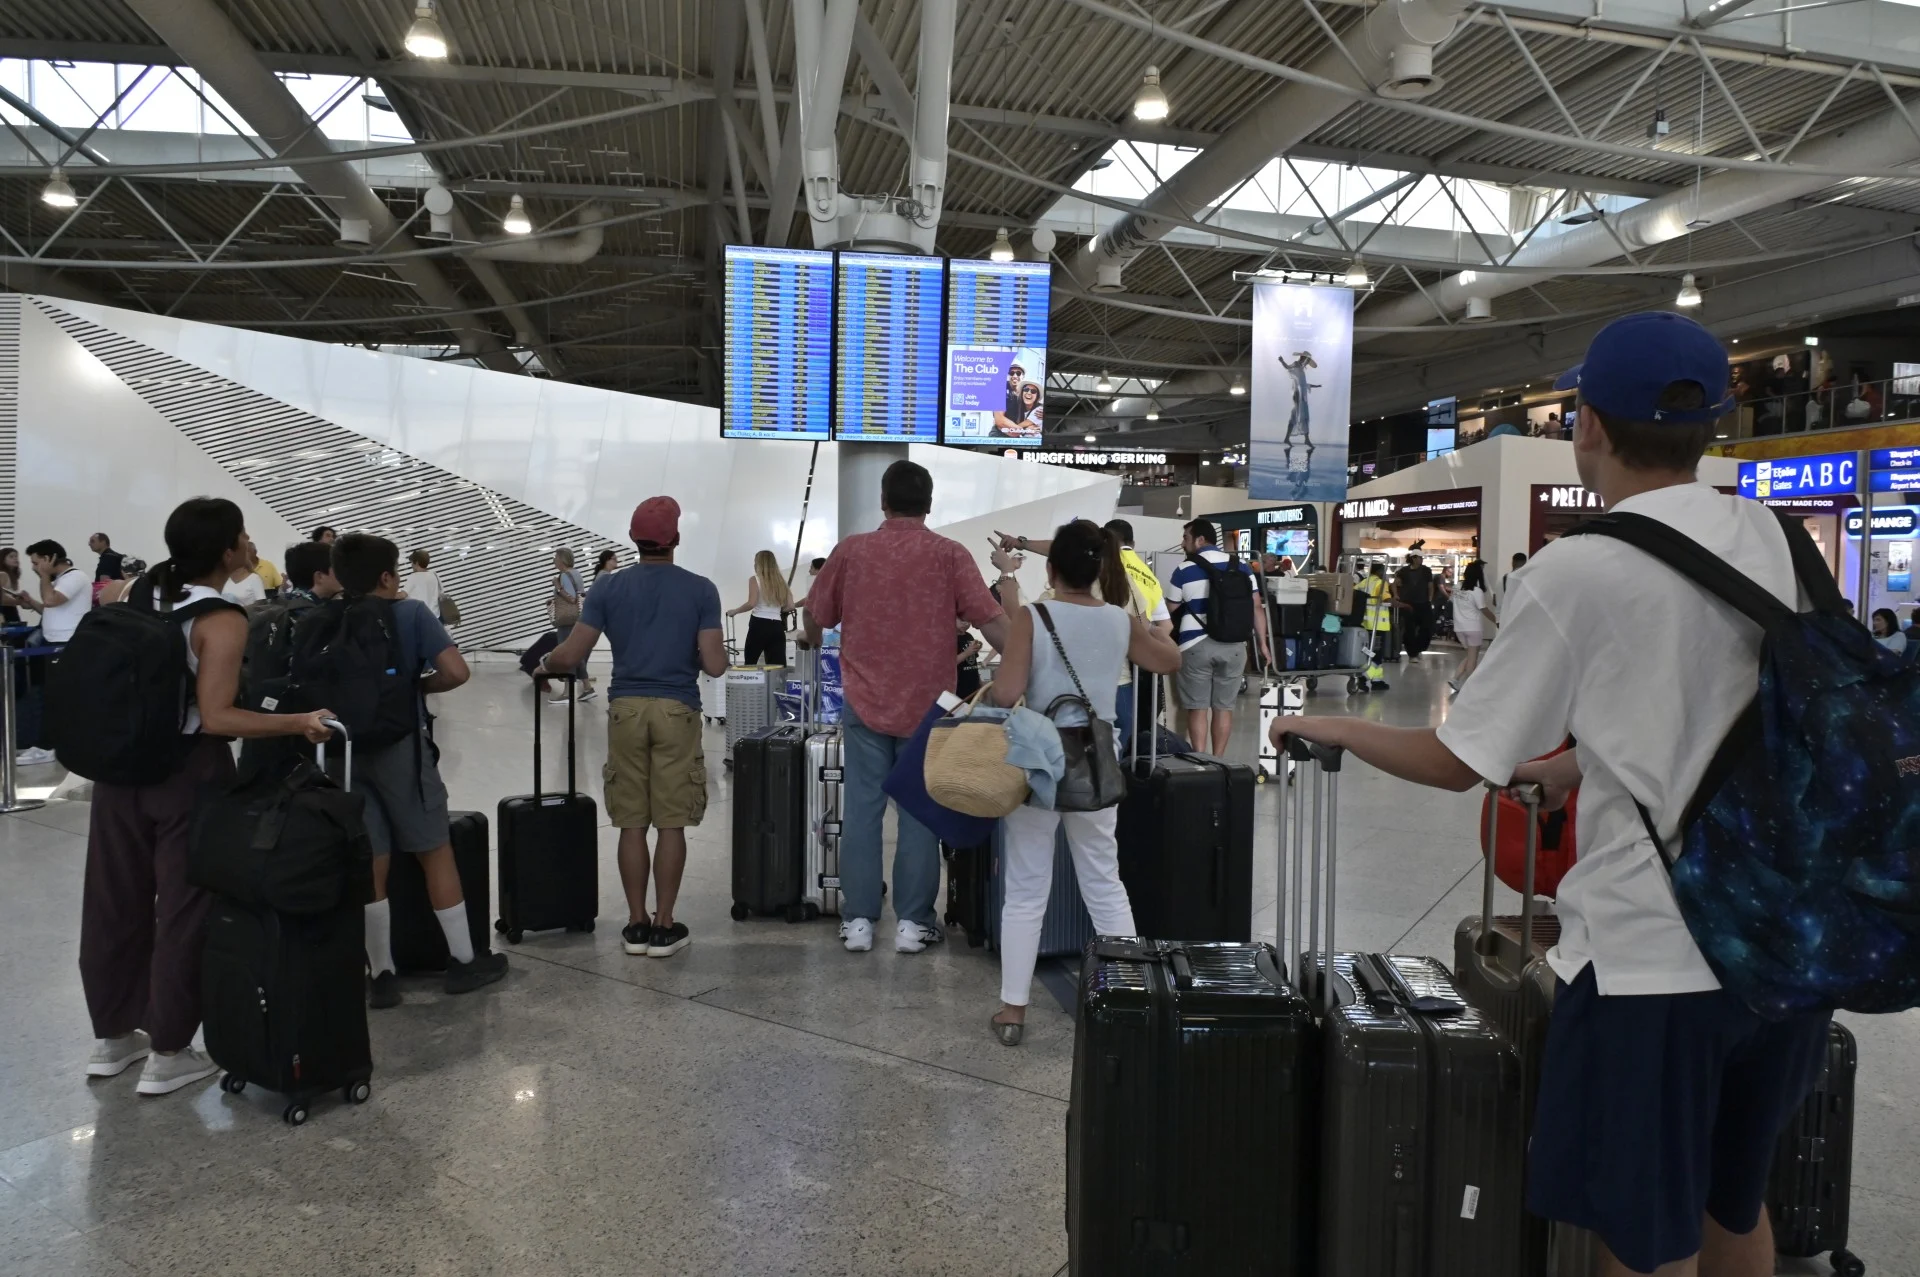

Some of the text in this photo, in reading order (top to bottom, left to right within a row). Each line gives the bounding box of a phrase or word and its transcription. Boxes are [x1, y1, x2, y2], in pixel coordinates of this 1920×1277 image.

[954, 363, 999, 374] The Club
[1076, 453, 1107, 465] KING
[1136, 453, 1166, 465] KING
[1799, 461, 1853, 488] A B C
[1773, 481, 1793, 490] Gates
[1890, 482, 1909, 490] Airport
[1552, 487, 1584, 507] PRET
[1587, 492, 1596, 507] A
[1849, 517, 1912, 529] EXHANGE
